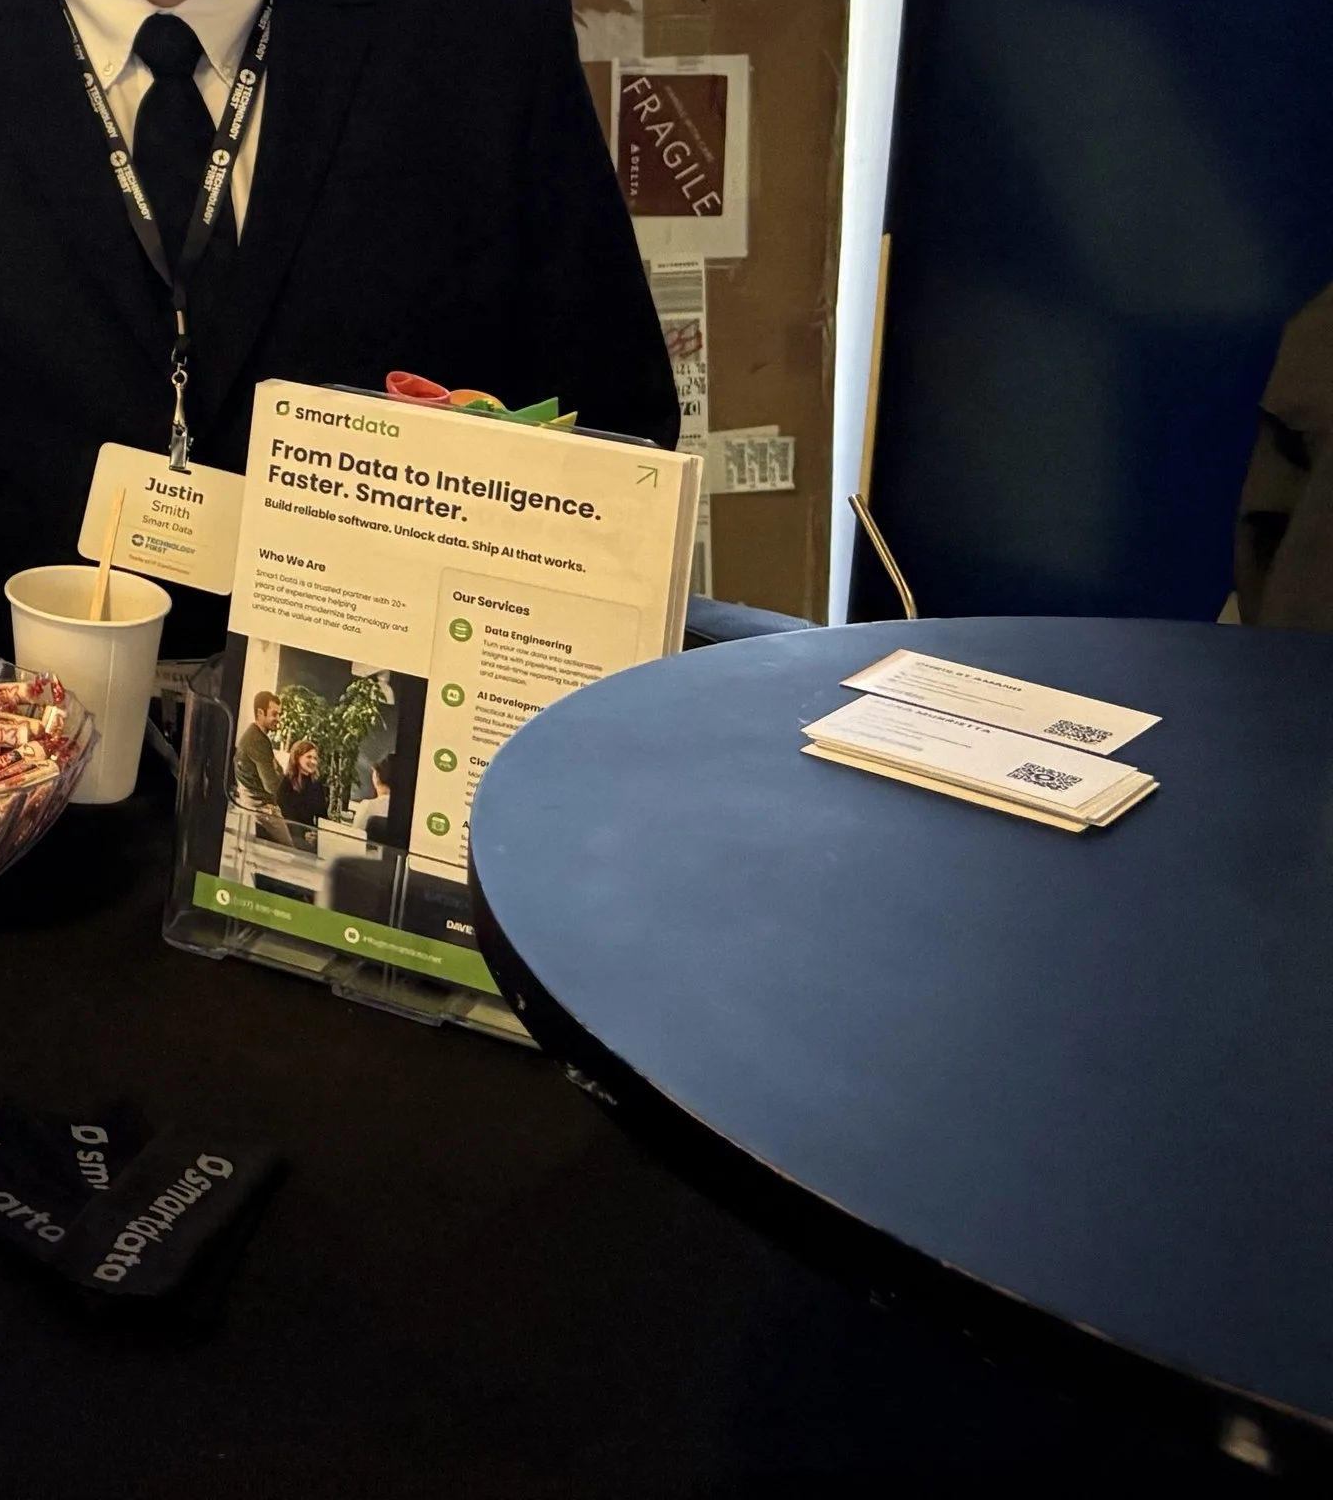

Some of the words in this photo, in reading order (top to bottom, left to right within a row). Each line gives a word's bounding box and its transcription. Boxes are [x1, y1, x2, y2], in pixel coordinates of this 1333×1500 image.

[90, 85, 118, 138] TECHNOLOGY
[230, 83, 245, 110] FIRST
[229, 86, 252, 141] TECHNOLOGY
[623, 77, 721, 217] FRAGILE
[115, 168, 132, 194] FIRST
[123, 164, 152, 220] TECHNOLOGY
[202, 164, 219, 191] FIRST
[203, 168, 226, 225] TECHNOLOGY
[295, 404, 400, 439] smartdata
[145, 477, 204, 505] Justin
[268, 464, 349, 499] Faster.
[355, 483, 468, 522] Smarter.
[270, 438, 333, 469] From
[338, 451, 398, 482] Data
[405, 465, 431, 488] to
[435, 470, 602, 521] Intelligence.
[142, 515, 170, 530] Smart
[172, 522, 193, 535] Data
[151, 500, 190, 520] Smith
[263, 497, 292, 514] Build
[293, 502, 336, 524] reliable
[337, 512, 392, 534] software.
[394, 524, 435, 543] Unlock
[437, 533, 470, 550] data.
[471, 540, 499, 557] Ship
[500, 545, 514, 559] AI
[515, 548, 543, 564] that
[544, 556, 587, 574] works.
[258, 548, 284, 563] Who
[286, 554, 304, 567] We
[306, 559, 326, 572] Are
[452, 591, 476, 604] Our
[477, 596, 530, 616] Services
[485, 625, 509, 638] Data
[510, 631, 572, 654] Engineering
[477, 691, 487, 701] AI
[93, 1168, 213, 1283] smartdata
